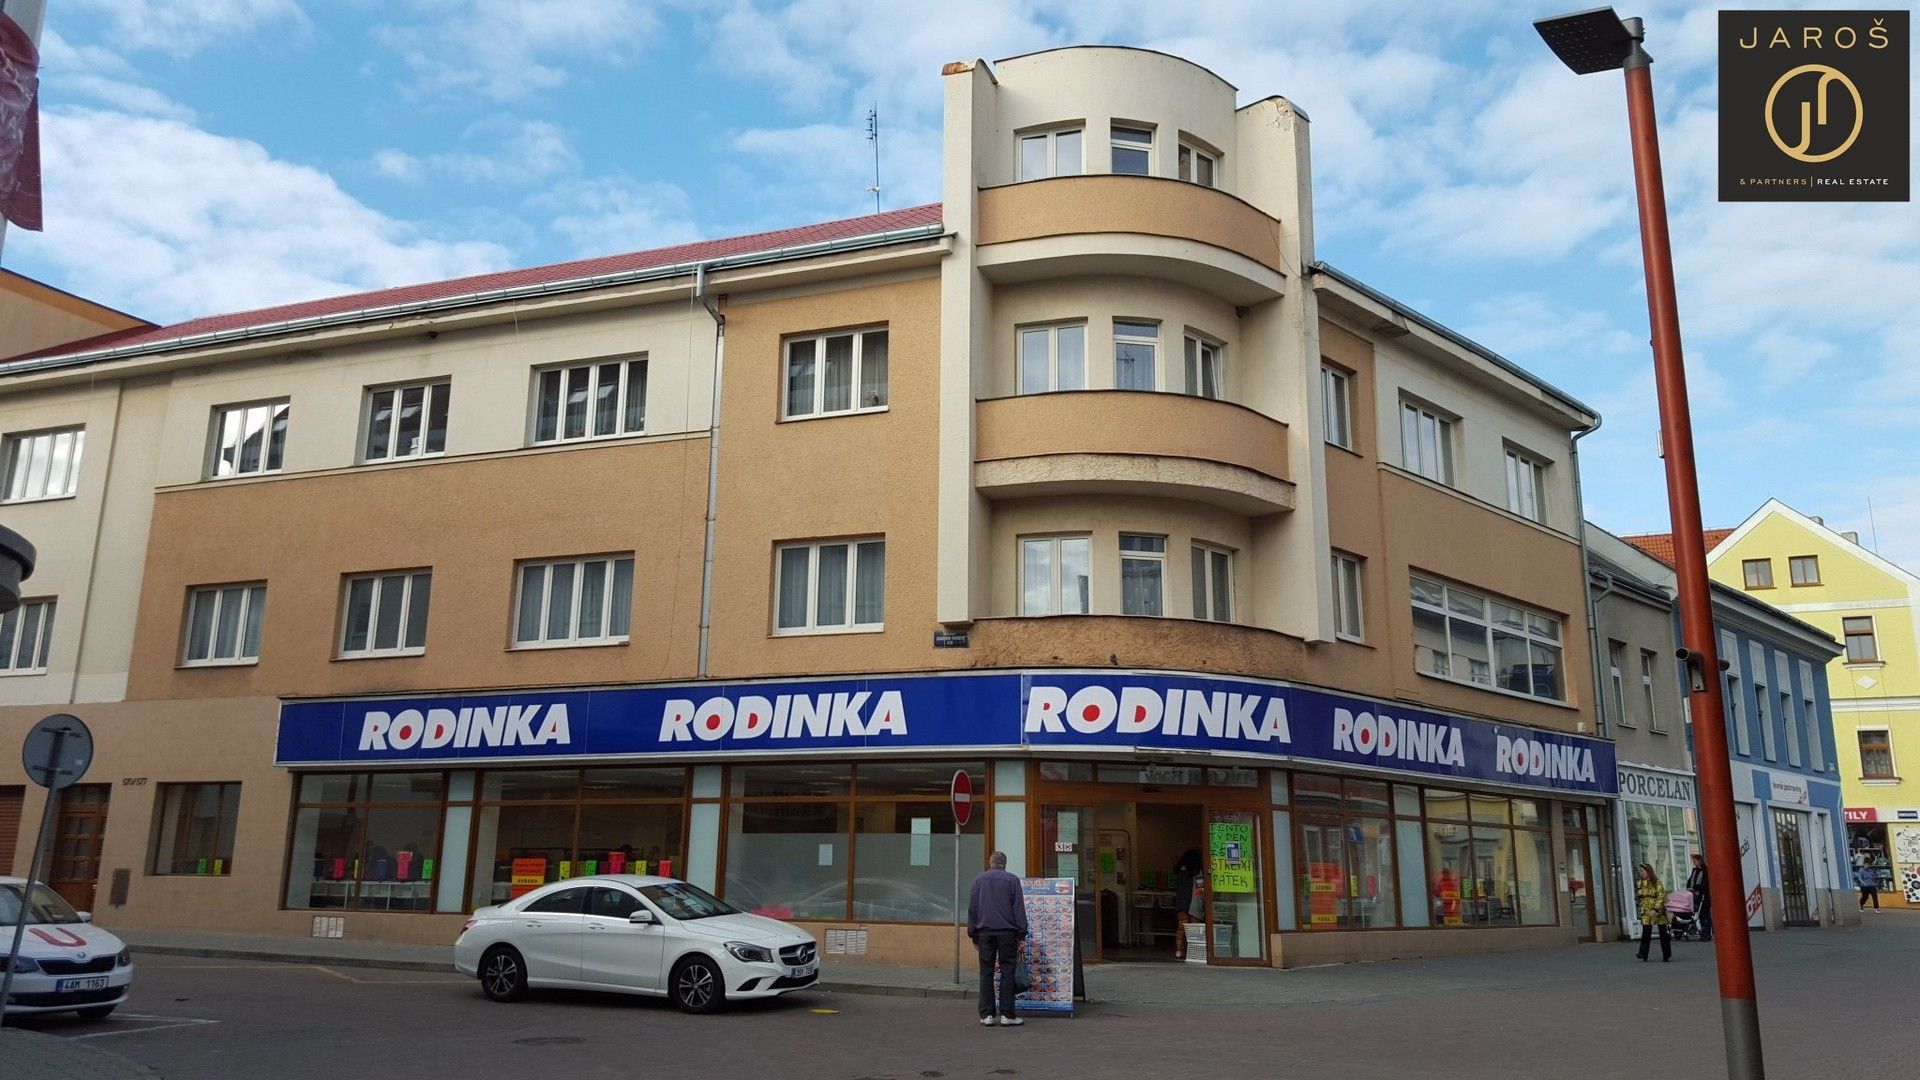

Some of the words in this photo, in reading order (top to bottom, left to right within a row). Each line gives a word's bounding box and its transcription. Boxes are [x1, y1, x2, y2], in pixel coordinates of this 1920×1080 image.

[359, 704, 571, 750] RODINKA
[659, 691, 907, 742] RODINKA
[1024, 686, 1291, 744] RODINKA
[1333, 708, 1466, 767] RODINKA
[1496, 735, 1596, 783] RODINKA
[1618, 771, 1691, 801] PORCELÁN
